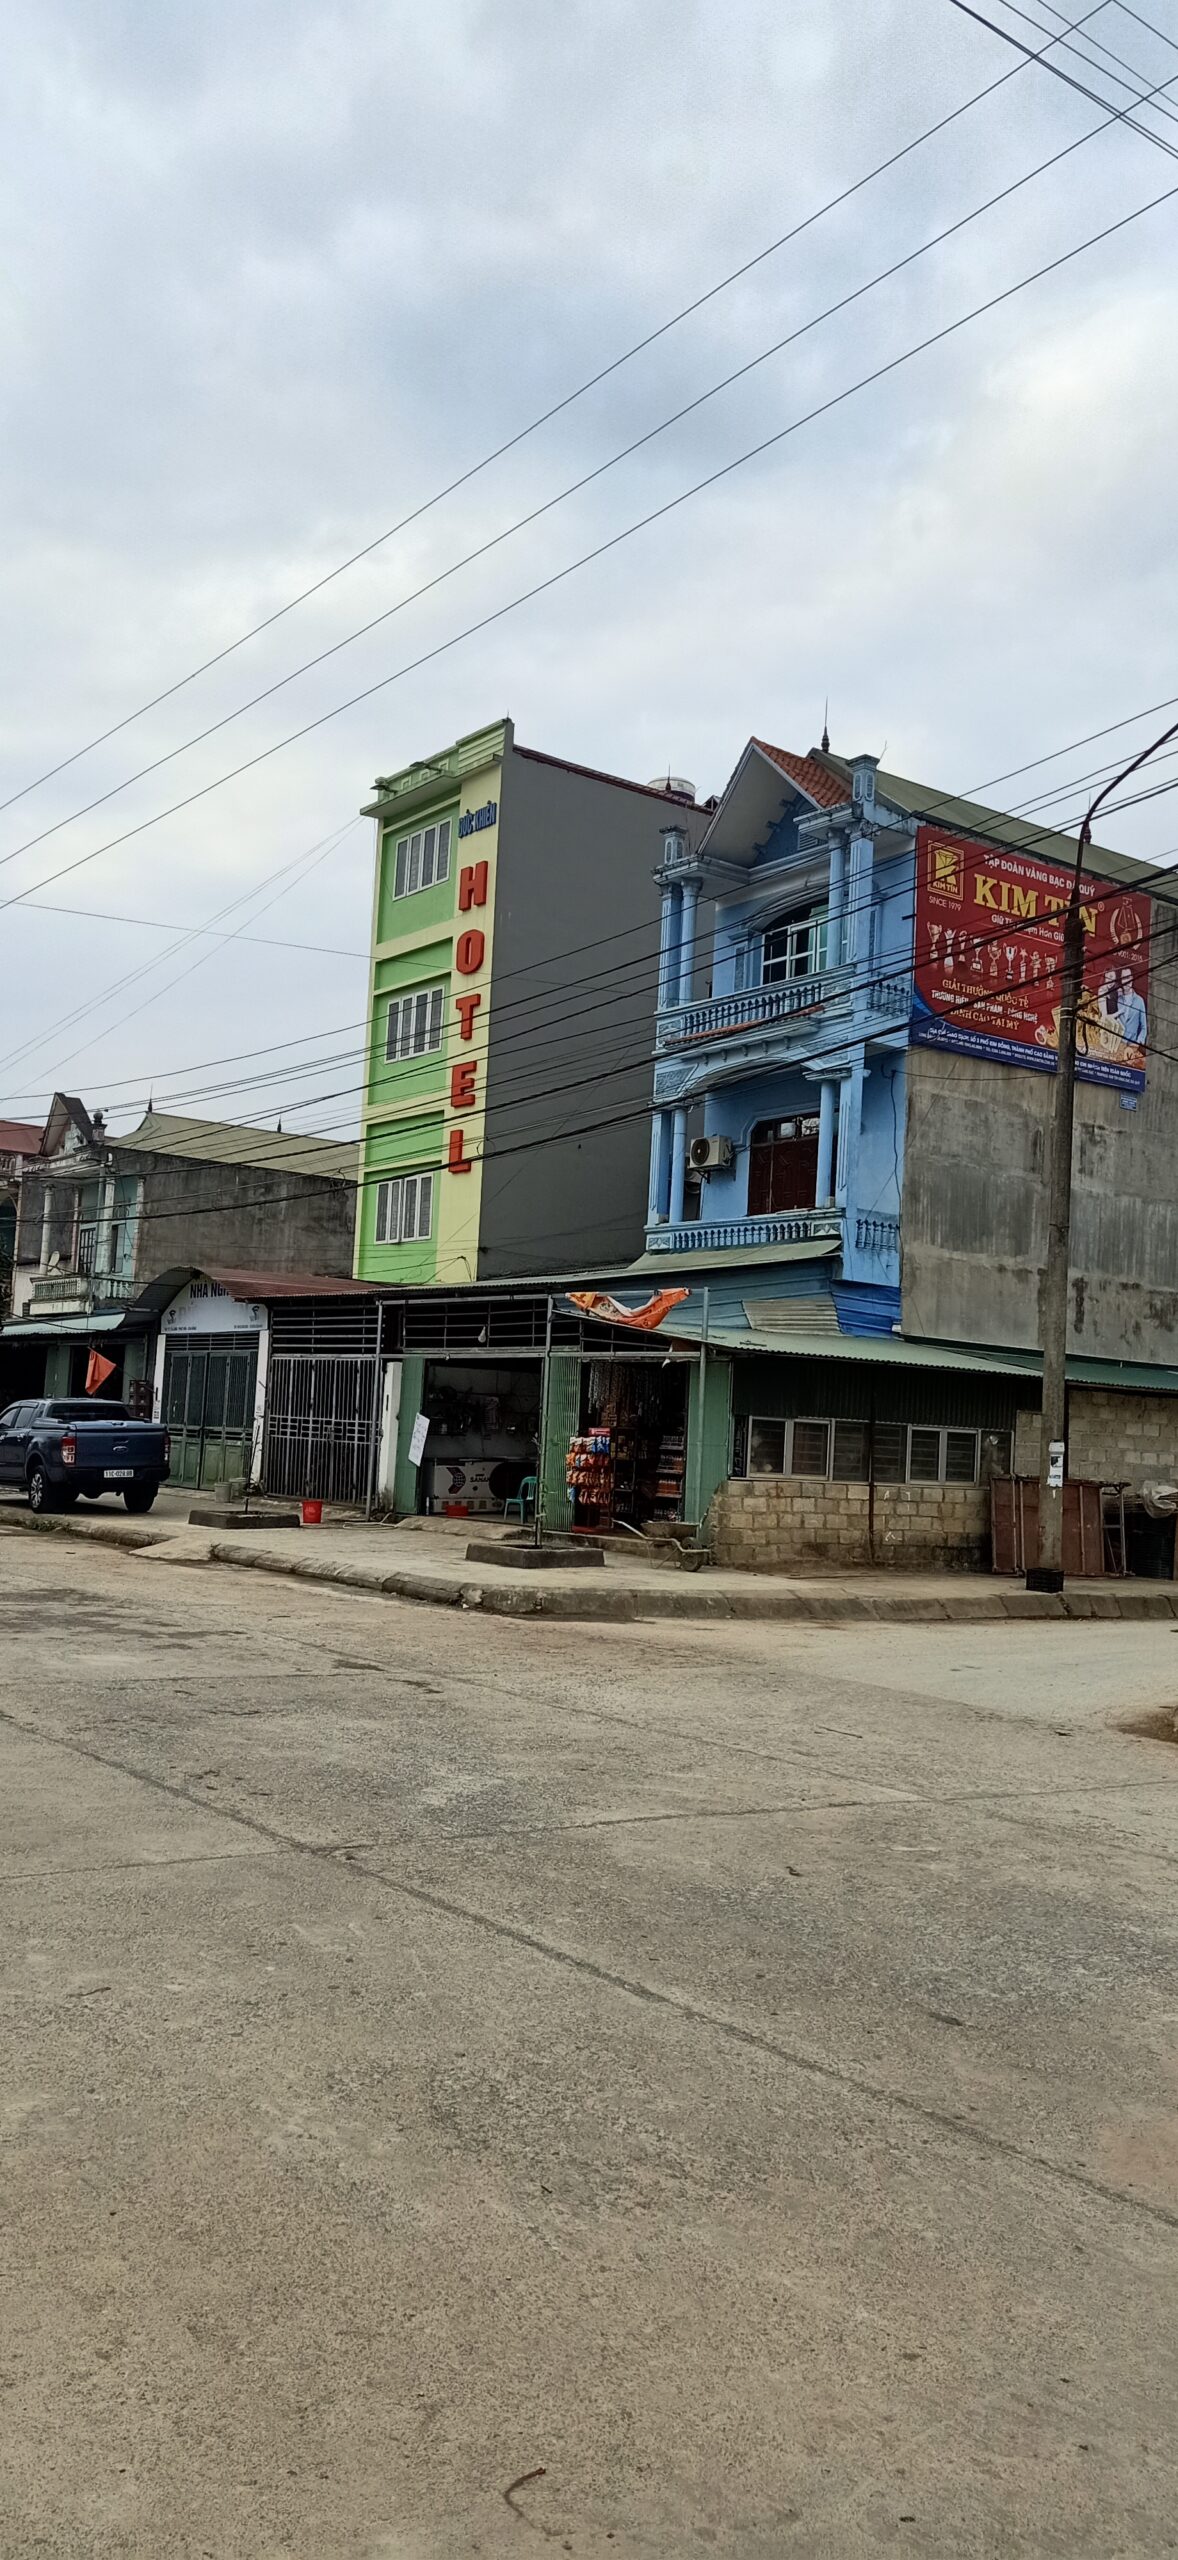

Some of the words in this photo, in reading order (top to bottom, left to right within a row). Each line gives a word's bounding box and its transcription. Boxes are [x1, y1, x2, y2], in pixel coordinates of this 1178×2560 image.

[933, 881, 946, 891] KIM
[1001, 861, 1024, 876] ĐOÀN
[1025, 866, 1048, 883] VÀNG
[1049, 874, 1065, 889] BẠC
[1079, 883, 1096, 898] QUÝ
[929, 896, 947, 908] SINCE
[948, 901, 962, 912] 1979
[973, 873, 1039, 919] KIM
[447, 860, 488, 1174] HOTEL
[190, 1279, 209, 1298] NHÀ
